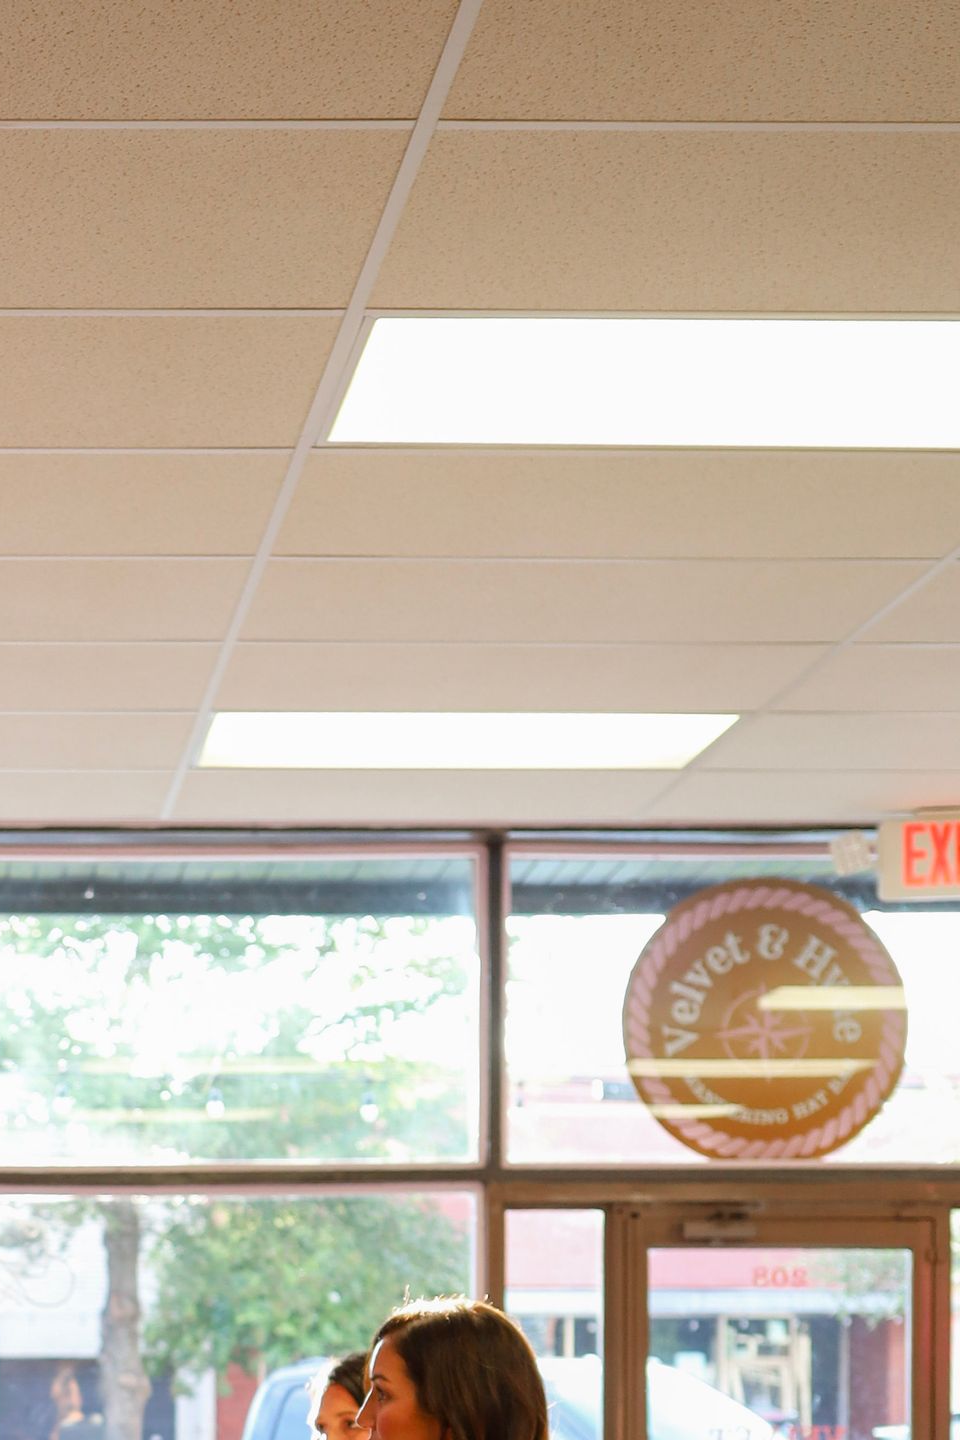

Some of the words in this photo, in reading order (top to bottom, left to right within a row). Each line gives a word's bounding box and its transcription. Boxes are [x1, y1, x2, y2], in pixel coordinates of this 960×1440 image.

[661, 930, 751, 1057] Velvet
[757, 923, 790, 961] &
[792, 933, 862, 1044] Hye
